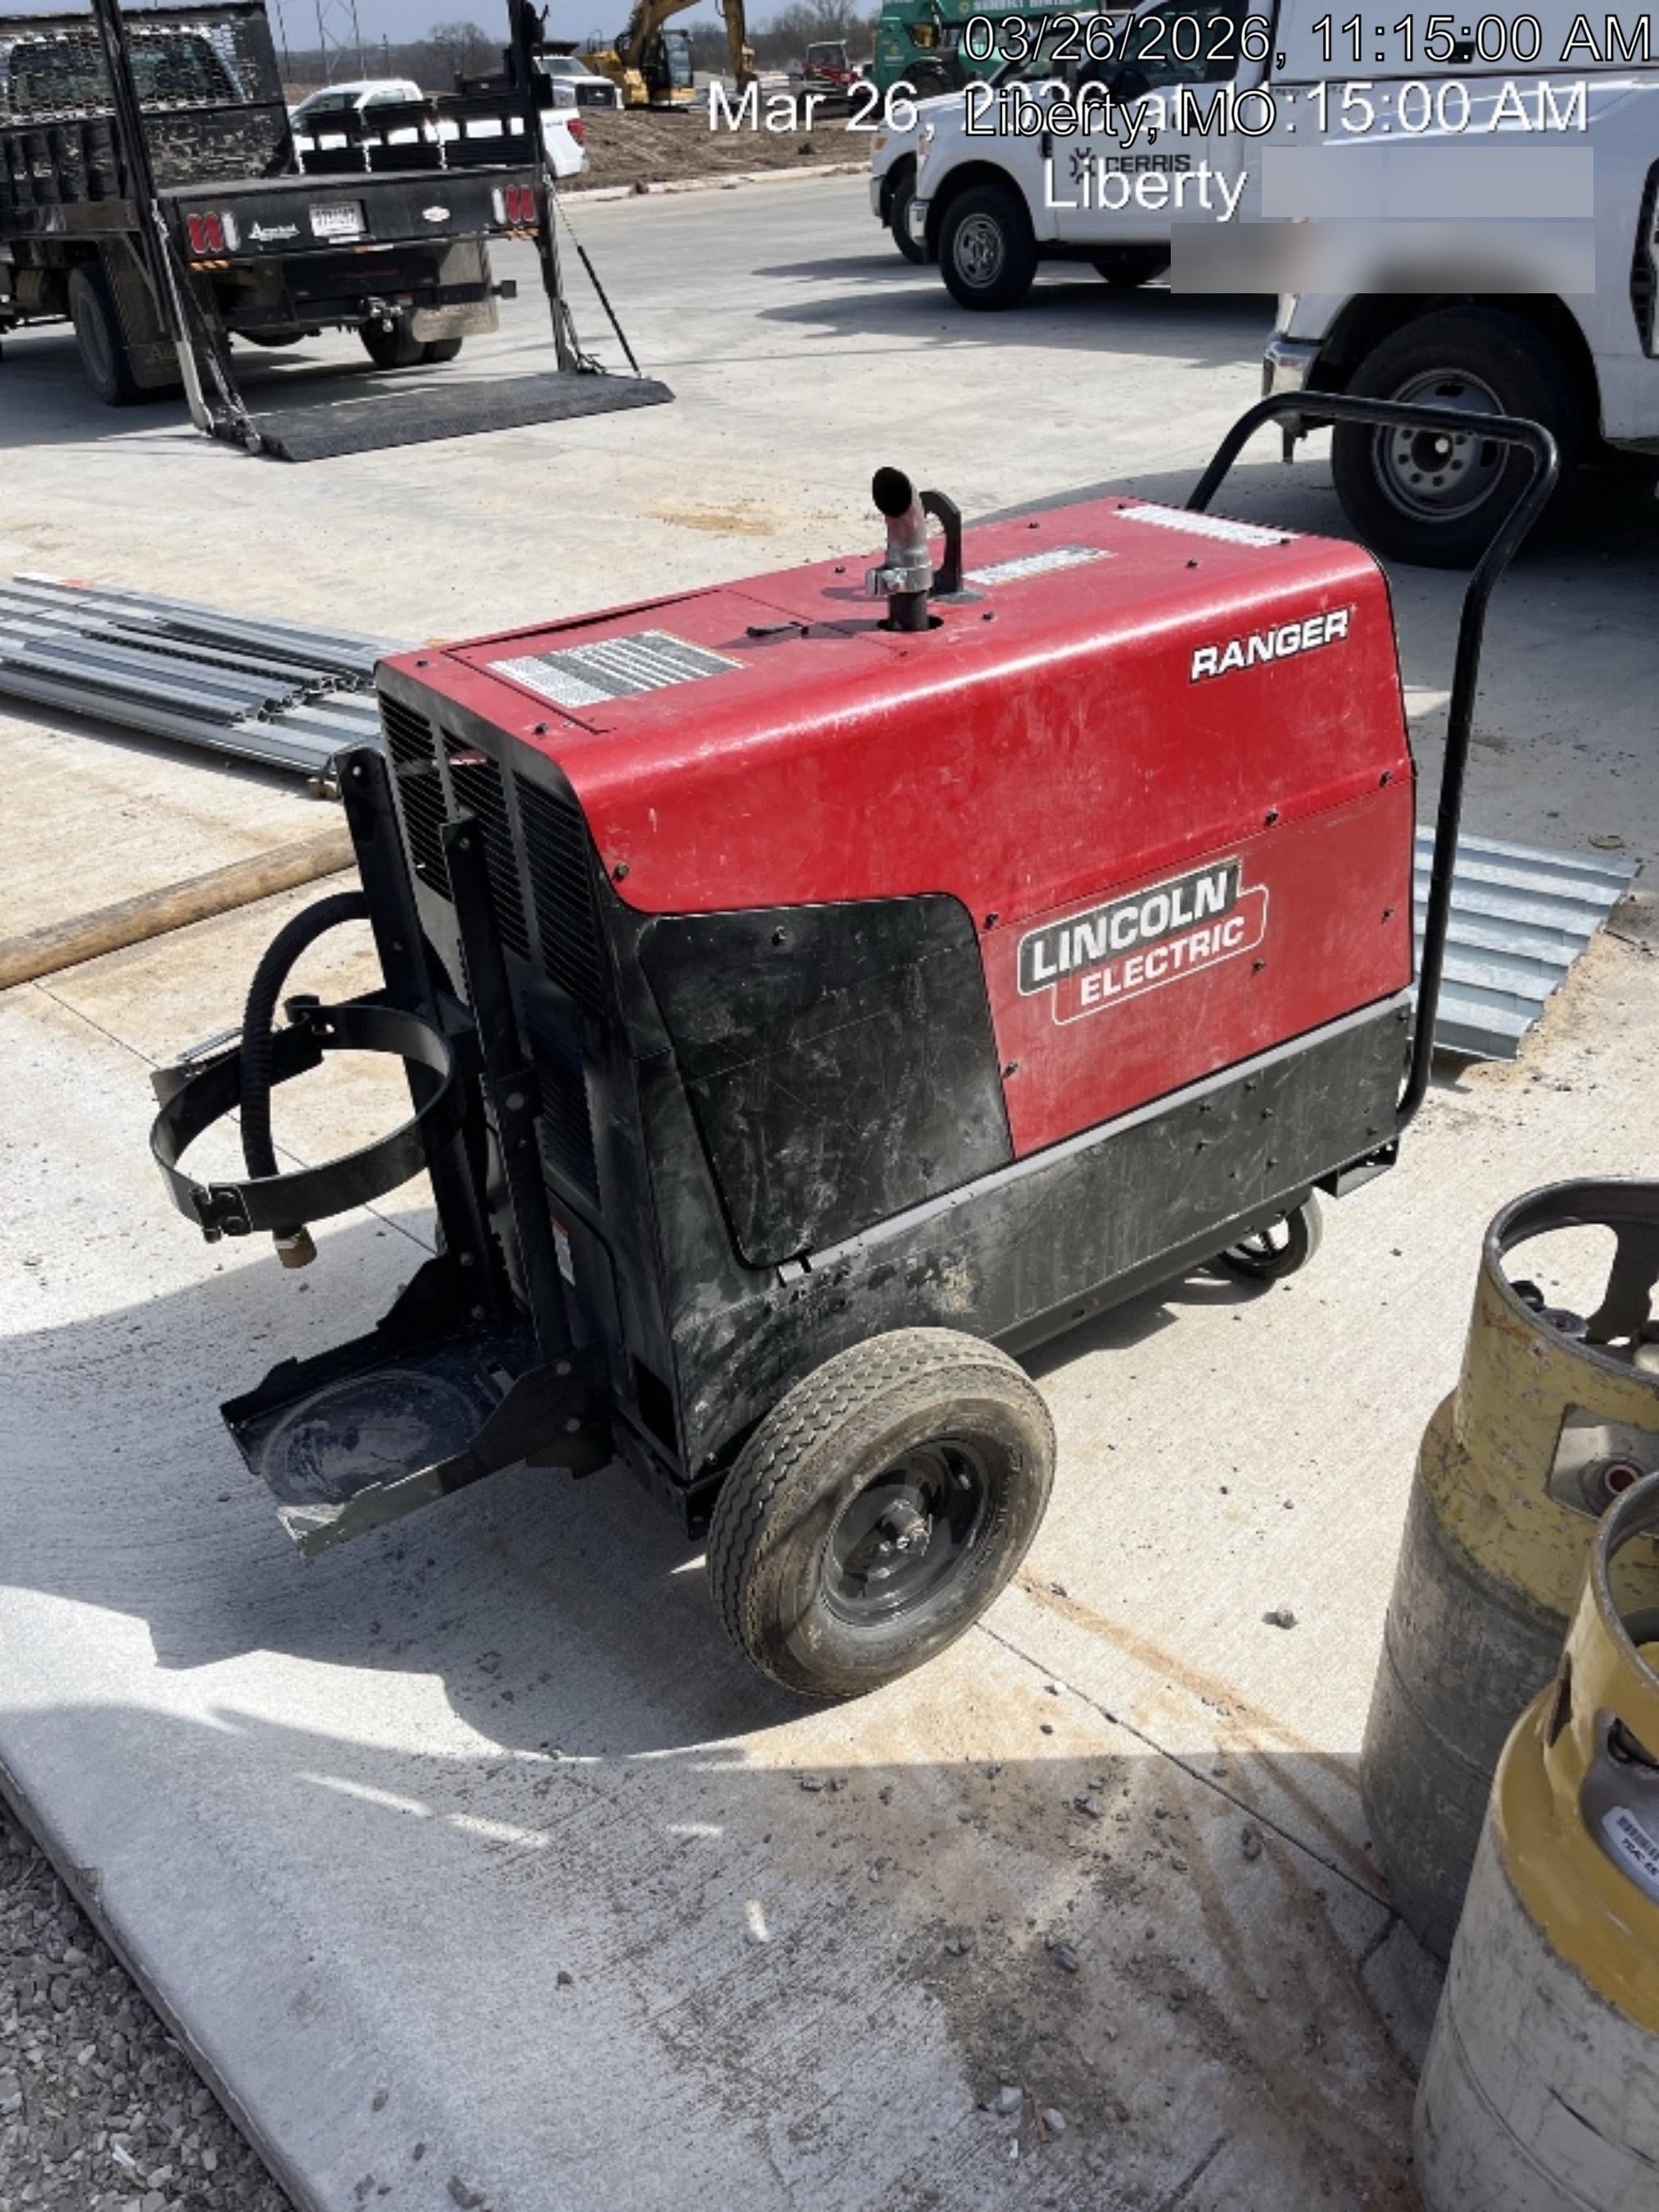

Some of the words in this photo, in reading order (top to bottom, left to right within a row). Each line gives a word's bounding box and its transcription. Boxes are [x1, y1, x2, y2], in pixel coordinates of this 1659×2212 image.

[1105, 153, 1191, 175] CERRIS
[1190, 606, 1352, 684] RANGER
[1032, 869, 1228, 981] LINCOLN
[1080, 915, 1245, 1006] ELECTRIC
